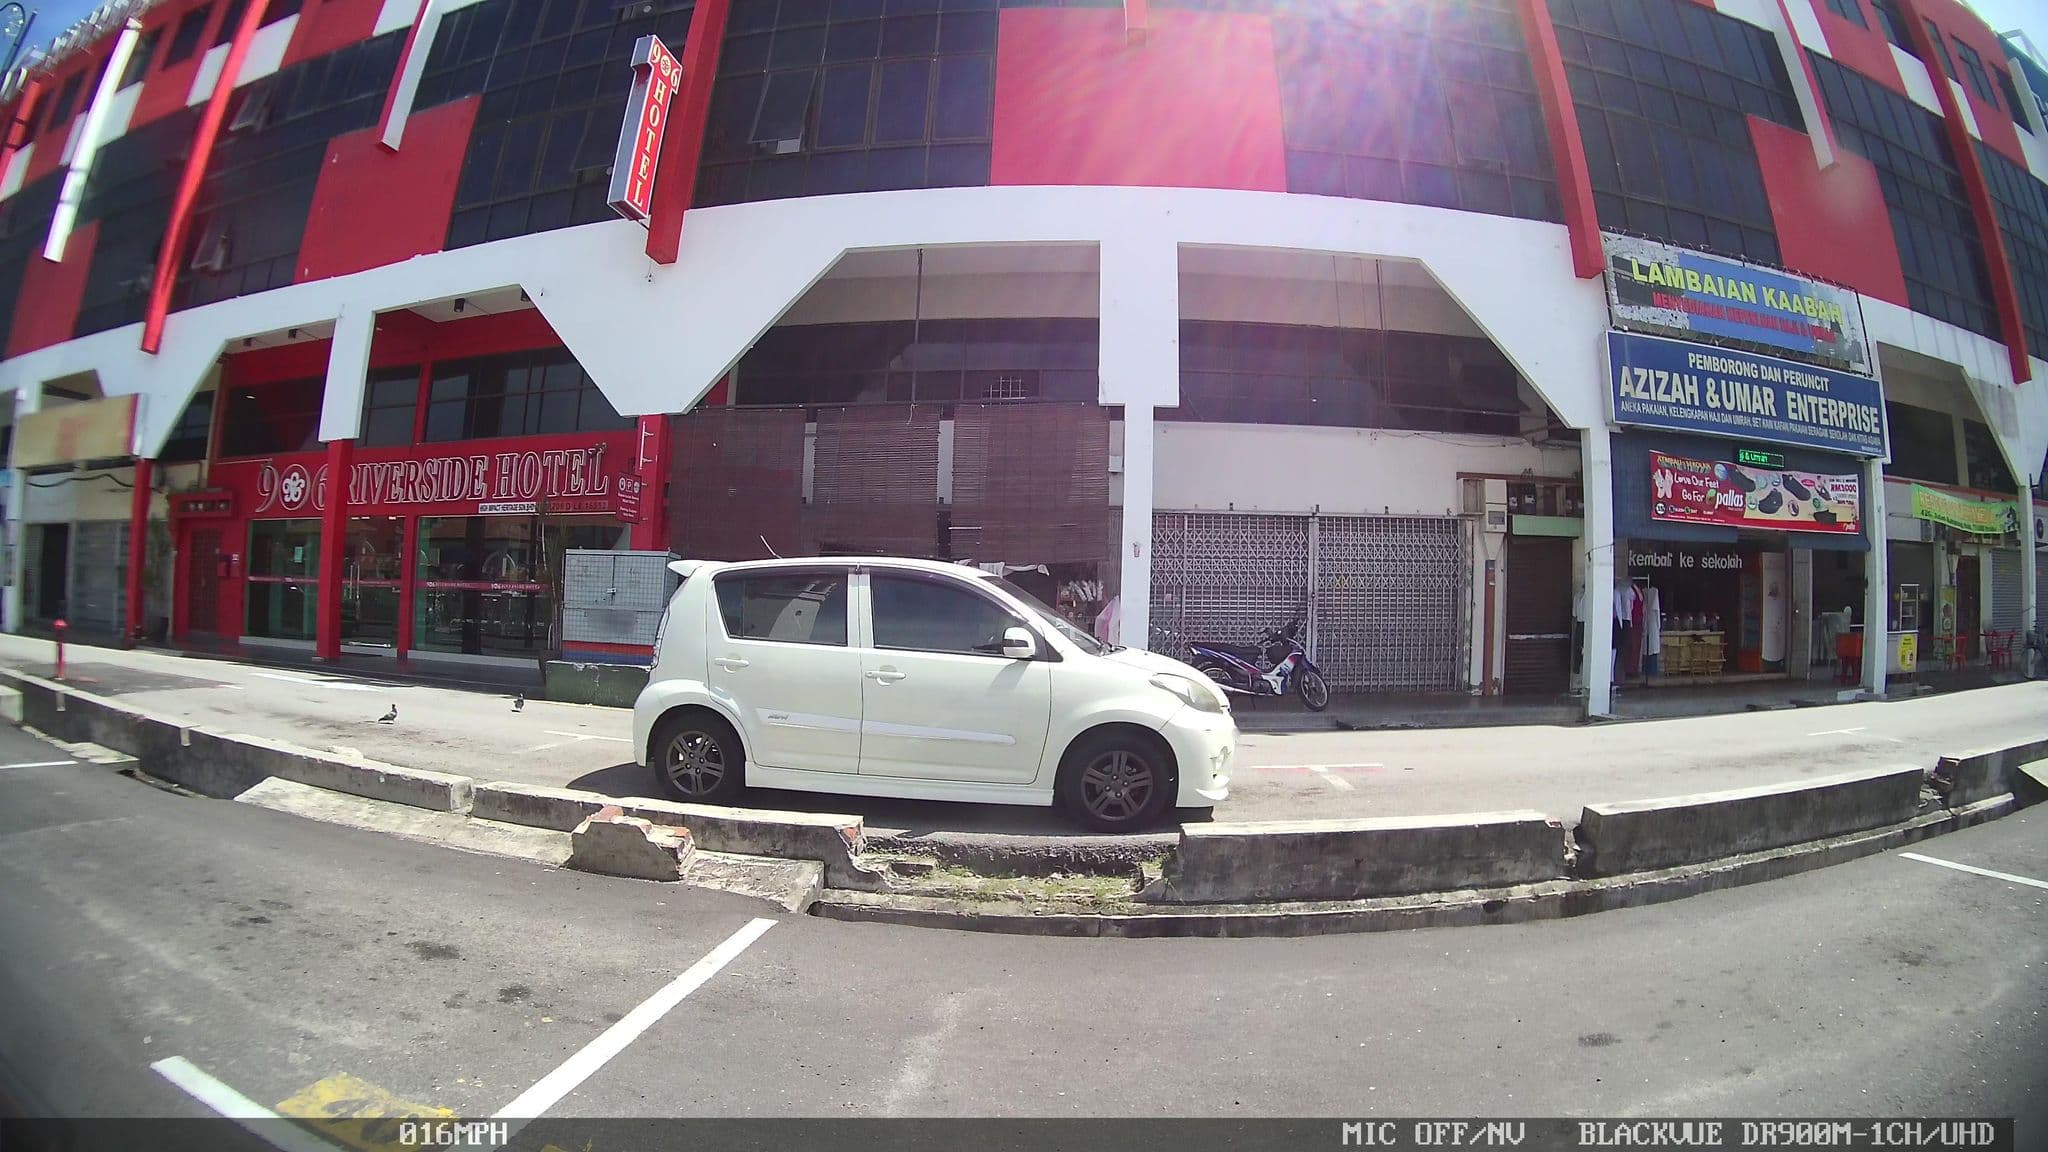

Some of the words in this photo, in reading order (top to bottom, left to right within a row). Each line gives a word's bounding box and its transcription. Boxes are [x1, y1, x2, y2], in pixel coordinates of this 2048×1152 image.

[633, 78, 668, 207] HOTEL
[1631, 257, 1756, 305] LAMBAIAN
[1762, 286, 1844, 326] KAABAH
[1688, 352, 1758, 379] PEMBORONG
[1761, 363, 1781, 383] DAN
[1784, 367, 1830, 392] PERUNCIT
[1619, 365, 1699, 407] AZIZAH
[1786, 391, 1881, 435] ENTERPRISE
[492, 448, 610, 500] HOTEL
[1681, 489, 1691, 501] Go
[1692, 490, 1705, 502] For
[1714, 489, 1744, 510] pallas
[1629, 551, 1673, 568] kembali
[1680, 551, 1694, 568] ke
[1701, 552, 1743, 569] sekolah
